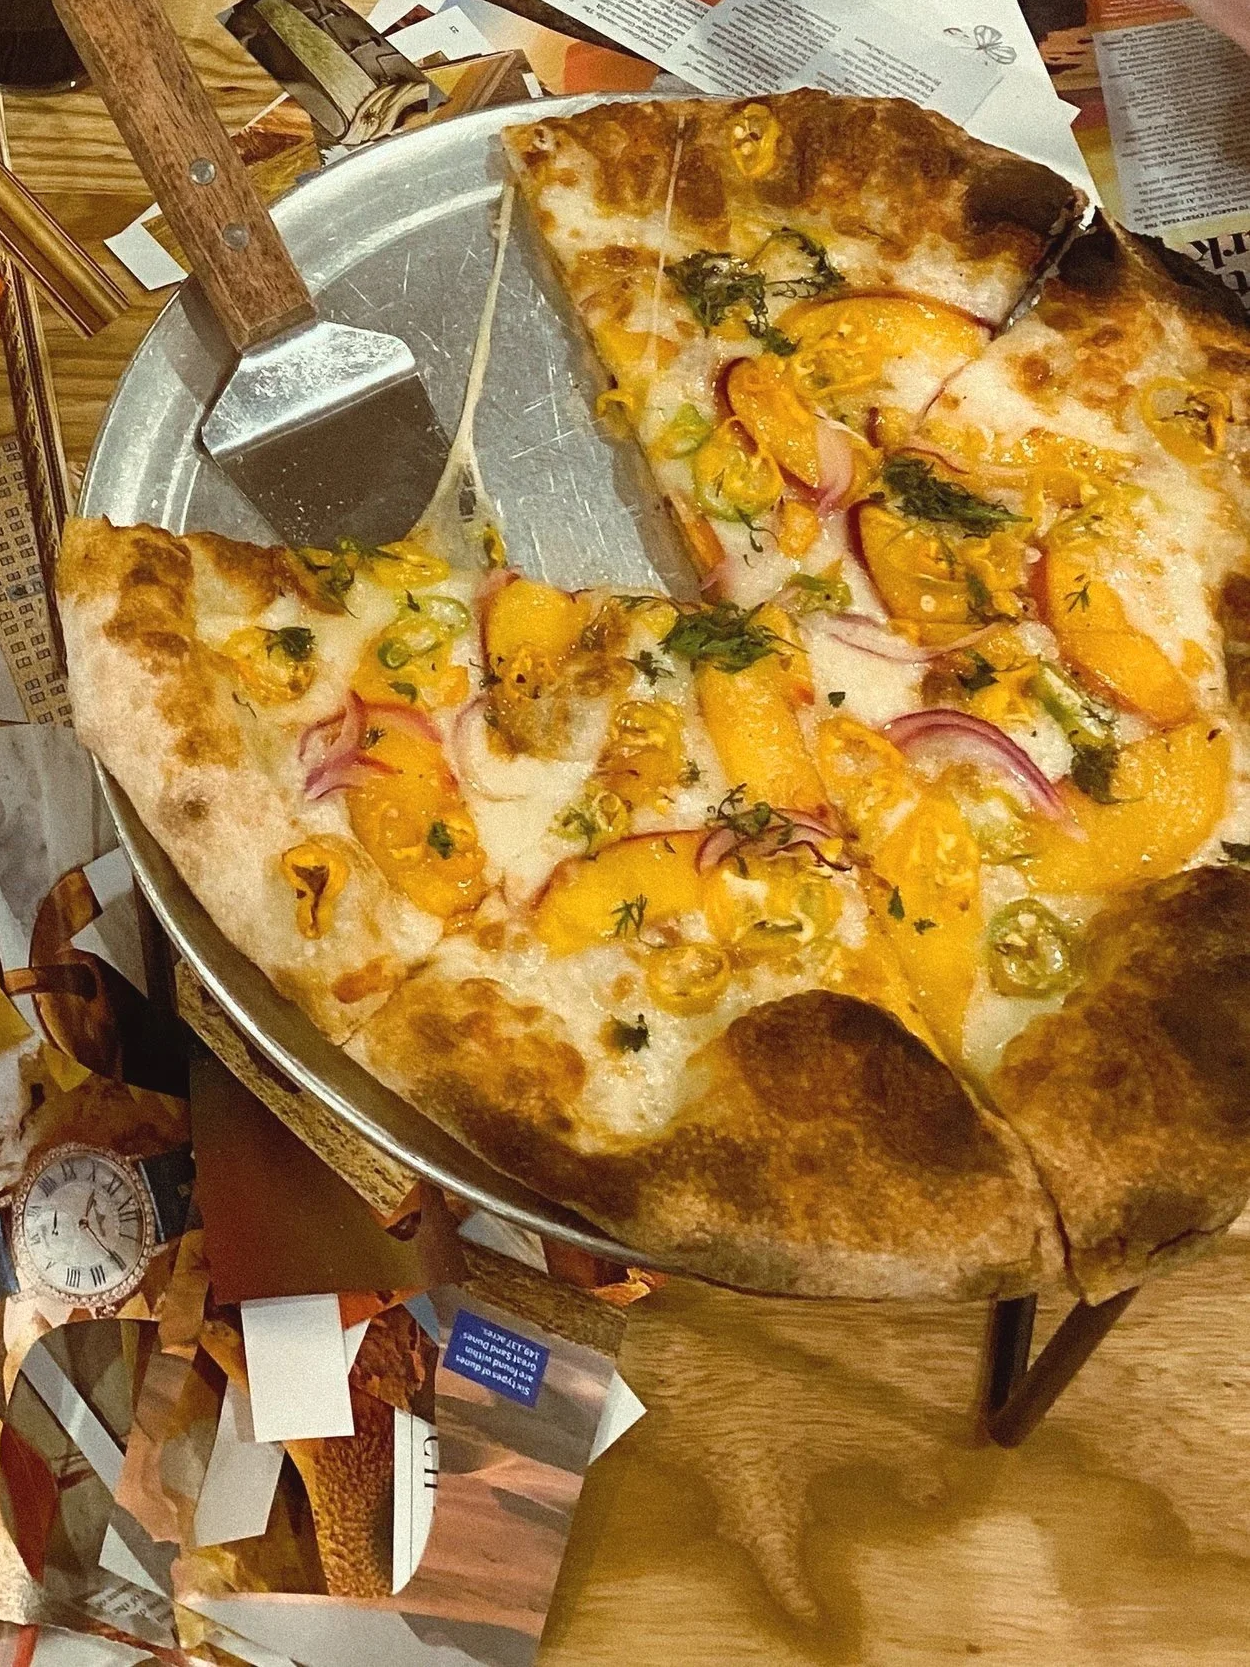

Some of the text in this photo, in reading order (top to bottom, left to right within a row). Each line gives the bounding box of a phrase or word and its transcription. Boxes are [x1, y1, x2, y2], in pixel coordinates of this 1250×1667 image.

[464, 1345, 534, 1383] are found within
[488, 1344, 512, 1361] Sand
[512, 1354, 537, 1372] Great
[454, 1353, 530, 1396] Six types of dunes
